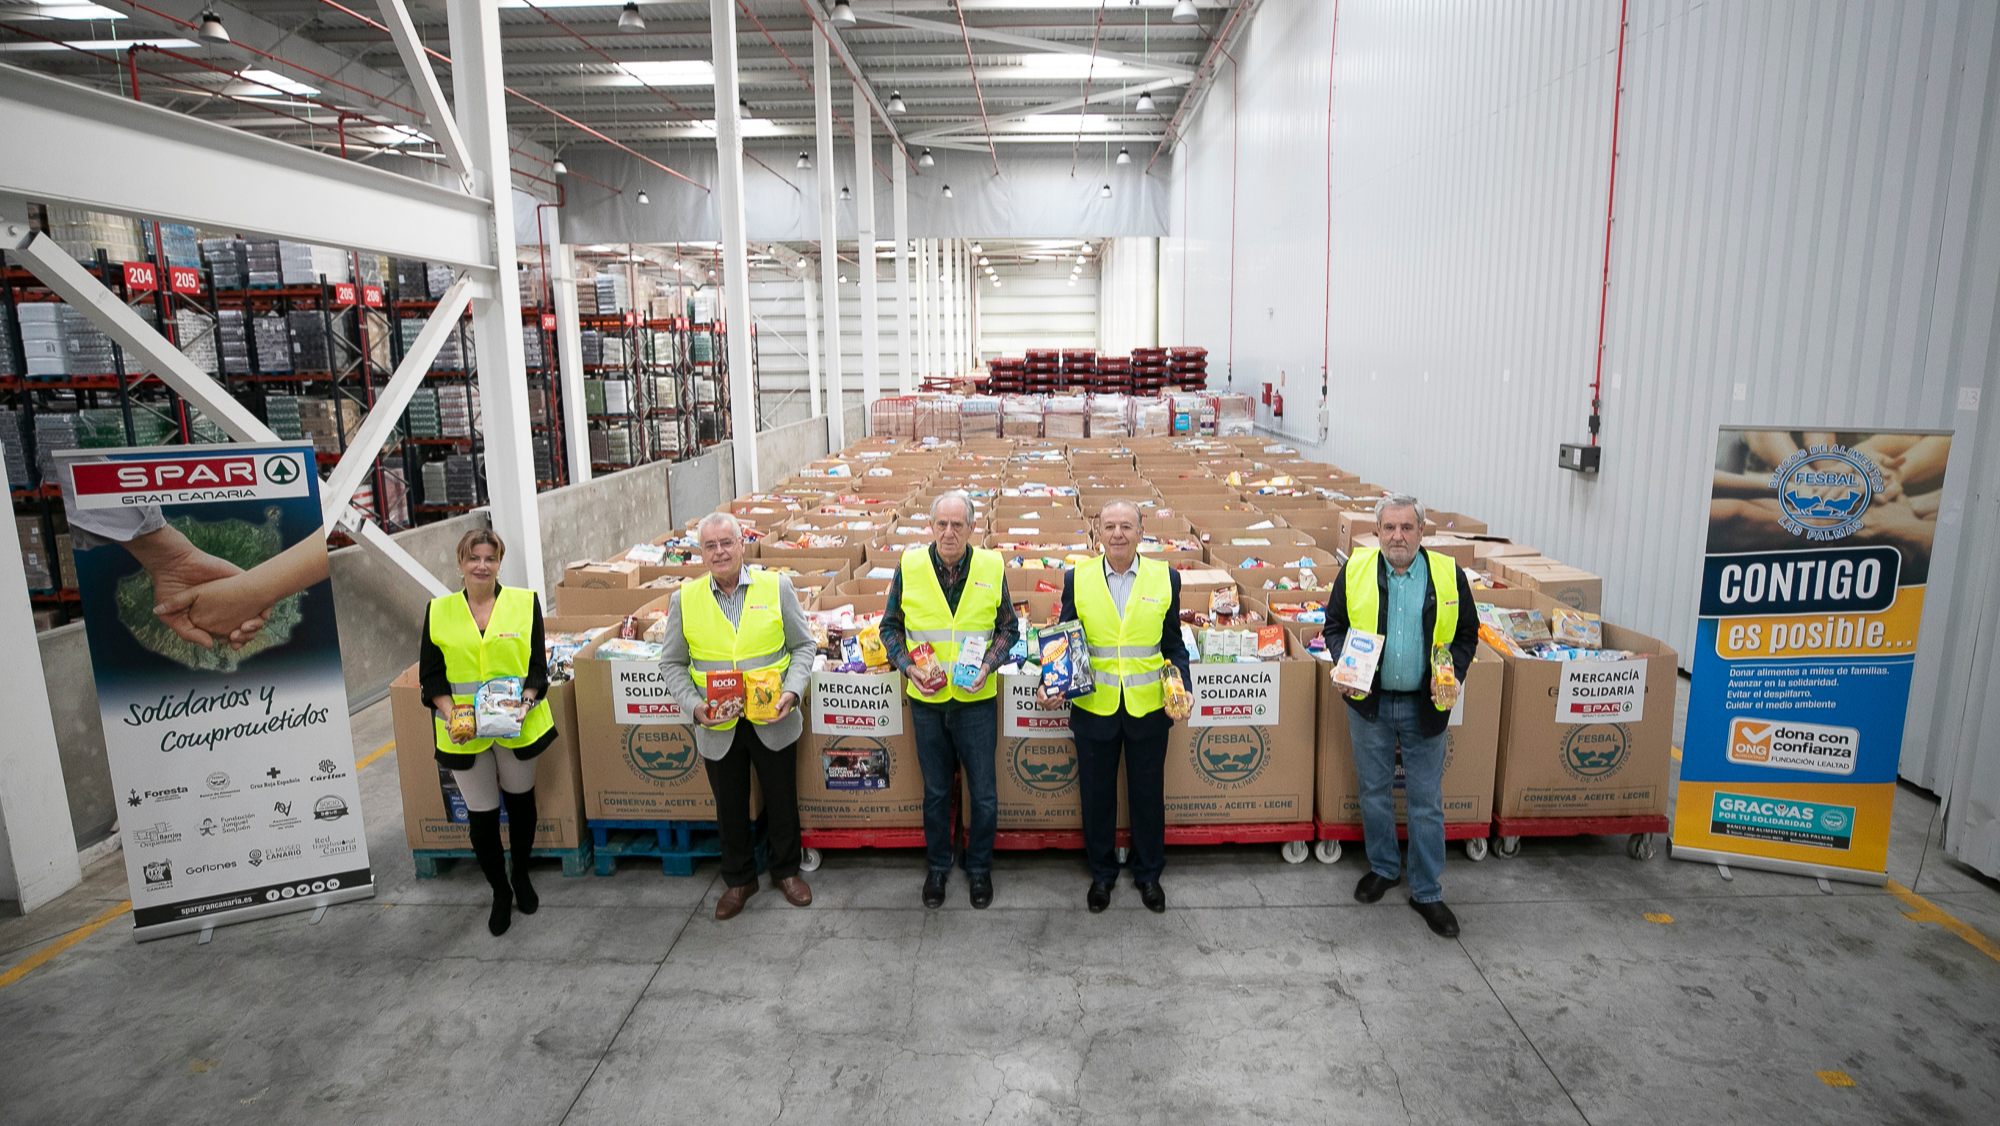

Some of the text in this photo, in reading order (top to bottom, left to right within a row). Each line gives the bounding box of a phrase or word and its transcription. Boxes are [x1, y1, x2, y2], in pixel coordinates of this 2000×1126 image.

[128, 267, 153, 284] 204
[174, 272, 196, 288] 205
[338, 287, 353, 299] 205
[366, 289, 380, 301] 206
[1768, 444, 1884, 493] BANCOS DE ALIMENTOS
[117, 462, 254, 488] SPAR
[1795, 472, 1859, 486] FESBAL
[121, 488, 256, 505] GRAN CANARIA
[1778, 516, 1865, 541] LAS PALMAS
[1719, 558, 1881, 604] CONTIGO
[1728, 615, 1913, 654] es posible...
[620, 672, 665, 683] MERCA
[1569, 668, 1639, 683] MERCANCÍA
[1729, 668, 1755, 677] Donar
[1757, 668, 1800, 677] alimentos
[1810, 667, 1834, 676] miles
[1837, 667, 1848, 675] de
[1850, 666, 1890, 676] familias.
[1197, 671, 1272, 685] MERCANCÍA
[1728, 679, 1762, 688] Avanzar
[1778, 679, 1786, 687] la
[1788, 678, 1839, 687] solidaridad.
[625, 687, 672, 697] SOLIDA
[818, 682, 893, 696] MERCANCÍA
[1201, 688, 1267, 699] SOLIDARIA
[1572, 685, 1635, 697] SOLIDARIA
[1727, 690, 1812, 700] Evitar el despilfarro.
[123, 685, 275, 727] Solidarios y
[639, 705, 680, 713] SPAR
[822, 698, 890, 710] SOLIDARIA
[1583, 704, 1620, 712] SPAR
[1725, 700, 1837, 710] Cuidar el medio ambiente
[1213, 706, 1252, 715] SPAR
[835, 715, 875, 725] SPAR
[1028, 719, 1069, 727] SPAR
[160, 702, 329, 752] Comprometidos
[638, 732, 686, 742] FESBAL
[1207, 733, 1253, 744] FESBAL
[1577, 733, 1619, 743] FESBAL
[1774, 727, 1849, 745] dona con
[1024, 745, 1071, 755] FESBAL
[1735, 743, 1767, 756] ONG
[1773, 742, 1852, 758] confianza
[1771, 756, 1850, 770] FUNDACIÓN LEALTAD
[669, 755, 705, 788] ALIMENTO
[1190, 755, 1271, 790] BANCOS DE ALIMENTOS
[144, 786, 188, 799] Foresta
[1523, 791, 1650, 802] CONSERVAS ACEITE LECHE
[604, 798, 656, 806] CONSERVAS
[1165, 800, 1293, 811] CONSERVAS ACEITE LECHE
[1444, 802, 1473, 810] LECHE
[798, 804, 923, 813] CONSERVAS ACEITE LECH
[1719, 811, 1812, 829] POR TU SOLIDARIDAD
[425, 825, 470, 833] CONSERVA
[1726, 823, 1746, 831] BANCO
[1756, 827, 1789, 836] ALIMENTOS
[1810, 833, 1834, 841] PALMAS
[315, 835, 331, 844] Red
[266, 849, 302, 861] CANARIO
[323, 845, 357, 855] Canaria
[181, 896, 253, 916] spargrancanaria.es
